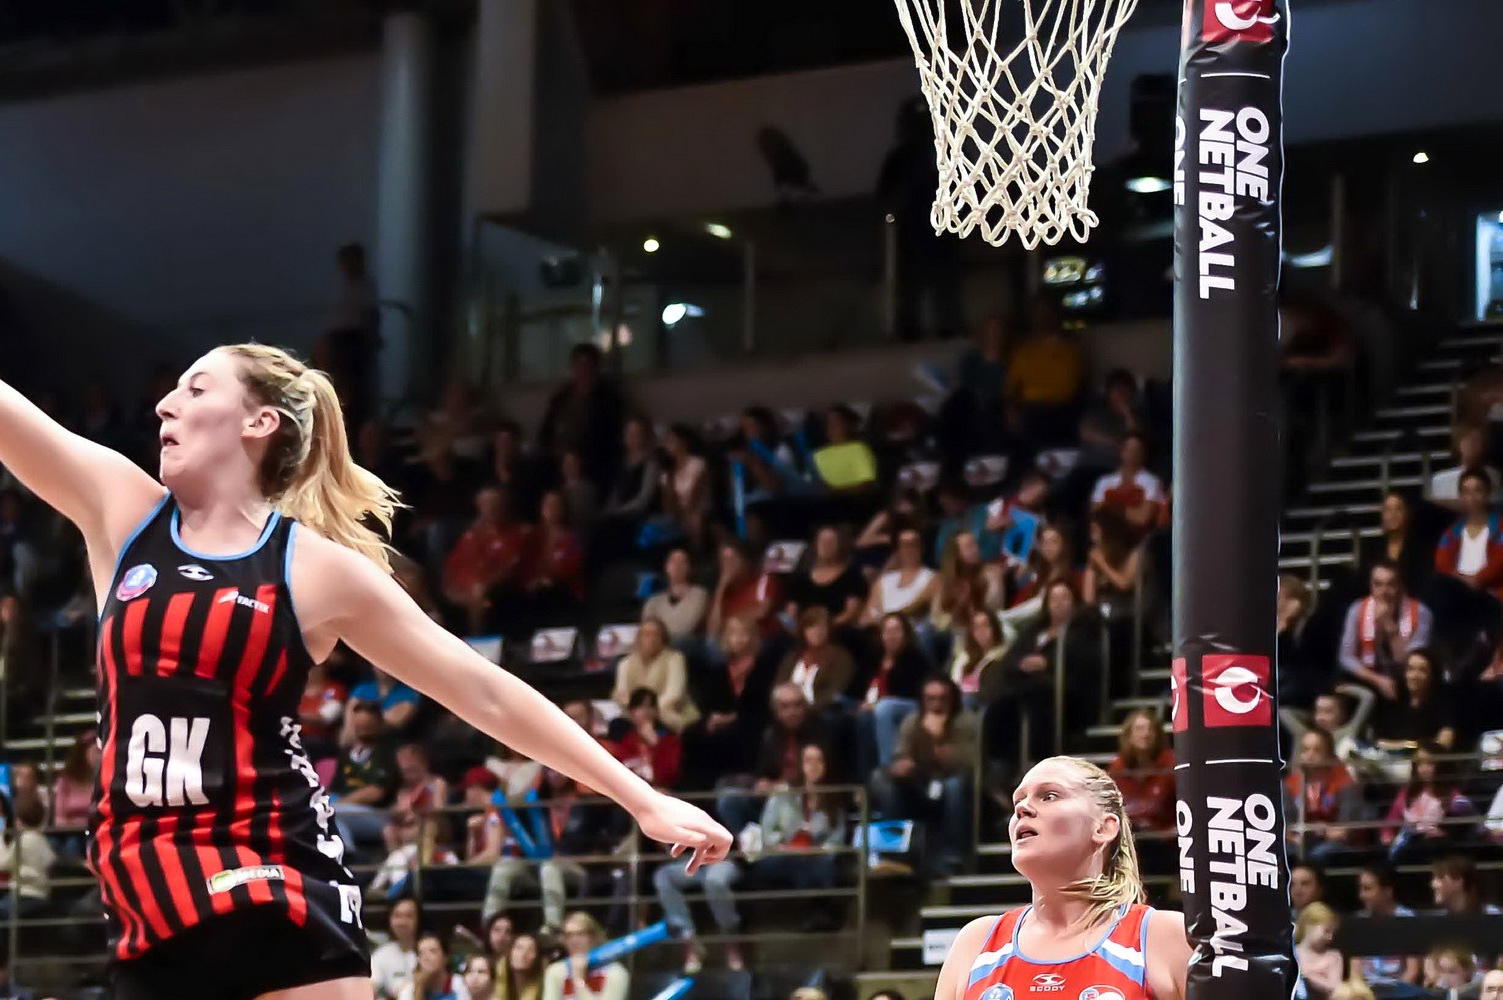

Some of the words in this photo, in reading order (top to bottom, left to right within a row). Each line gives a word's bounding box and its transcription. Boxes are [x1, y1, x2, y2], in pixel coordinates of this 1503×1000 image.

[1236, 107, 1270, 201] ONE
[1199, 108, 1236, 299] NETBALL
[125, 713, 211, 807] GK
[1176, 800, 1195, 894] ONE
[1206, 796, 1249, 978] NETBALL
[1244, 793, 1279, 889] ONE
[1029, 985, 1066, 993] SCODY
